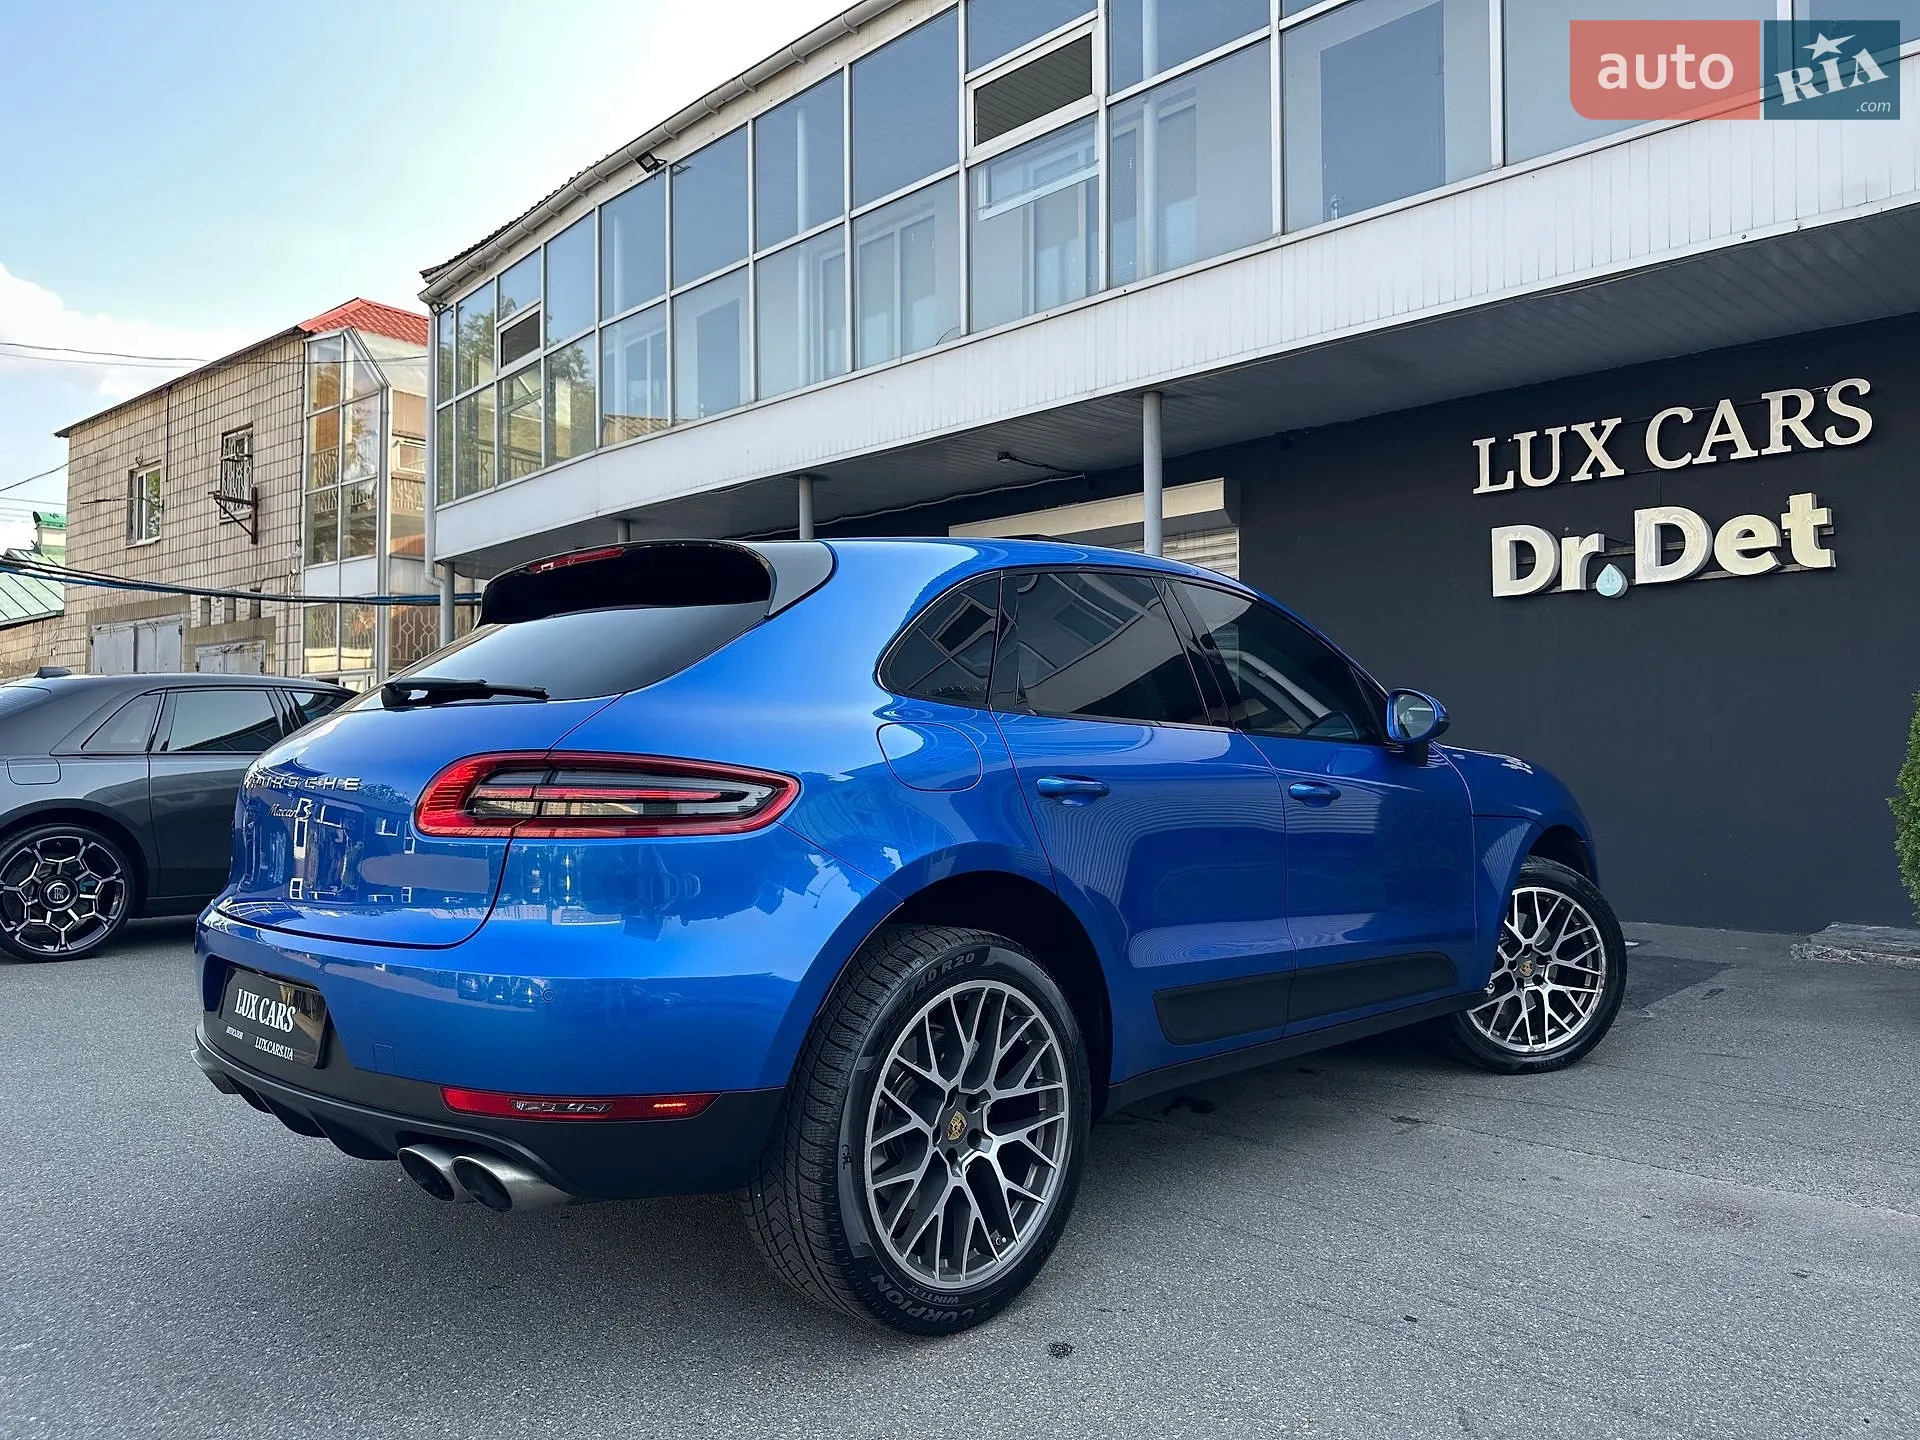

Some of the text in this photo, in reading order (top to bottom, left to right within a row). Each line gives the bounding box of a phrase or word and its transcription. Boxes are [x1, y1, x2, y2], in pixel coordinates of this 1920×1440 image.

[1472, 377, 1874, 494] LUX CARS
[234, 987, 260, 1020] LUX
[259, 997, 296, 1033] CARS
[907, 1284, 960, 1305] WINTER
